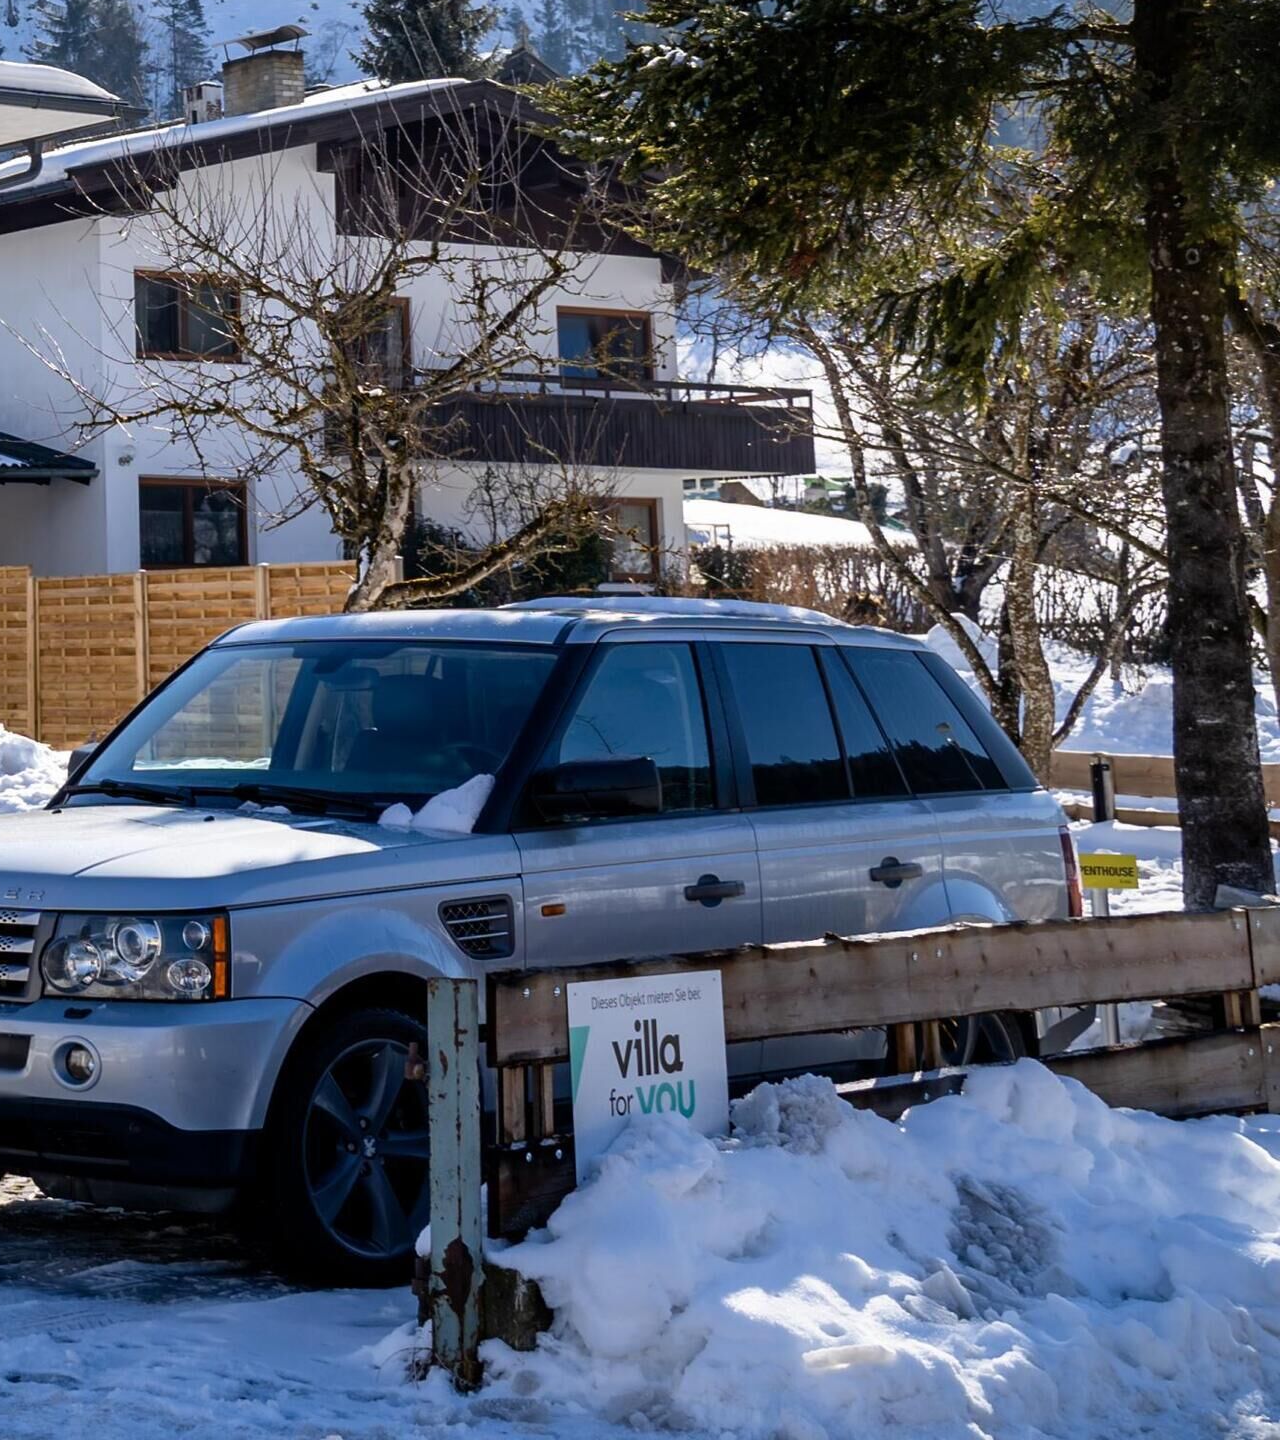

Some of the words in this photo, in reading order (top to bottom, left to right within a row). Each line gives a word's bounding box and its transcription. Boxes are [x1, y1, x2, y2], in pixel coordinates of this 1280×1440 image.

[590, 996, 618, 1010] Dieses
[618, 992, 646, 1010] Objekt
[646, 992, 674, 1005] mieten
[674, 988, 687, 1002] Sie
[612, 1018, 684, 1079] villa
[609, 1088, 634, 1117] for
